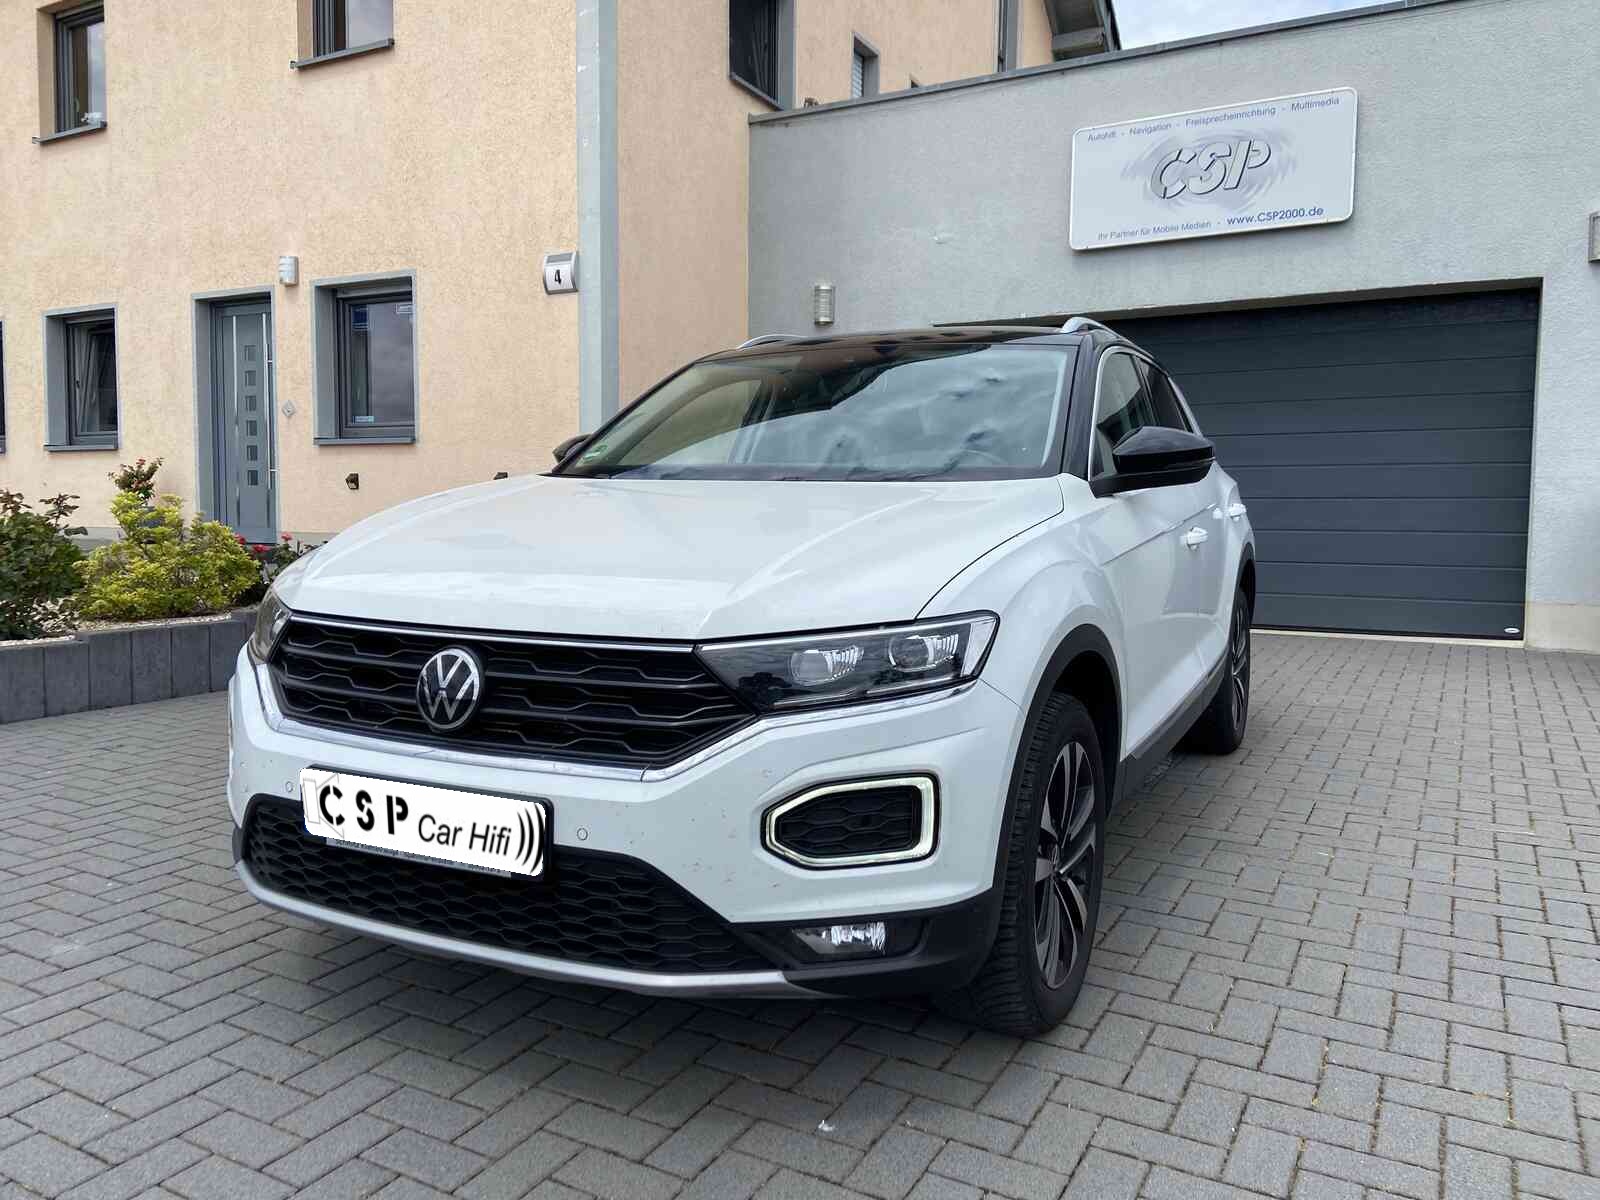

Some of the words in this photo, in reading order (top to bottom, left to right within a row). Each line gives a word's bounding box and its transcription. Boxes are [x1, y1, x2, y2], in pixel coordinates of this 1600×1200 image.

[1129, 122, 1172, 136] Navigation
[1291, 96, 1340, 112] Multimedia
[1150, 138, 1272, 199] CSP
[1110, 229, 1139, 240] Partner
[1181, 221, 1212, 233] Medien
[1226, 206, 1325, 226] www.CSP2000.de
[554, 269, 562, 285] 4
